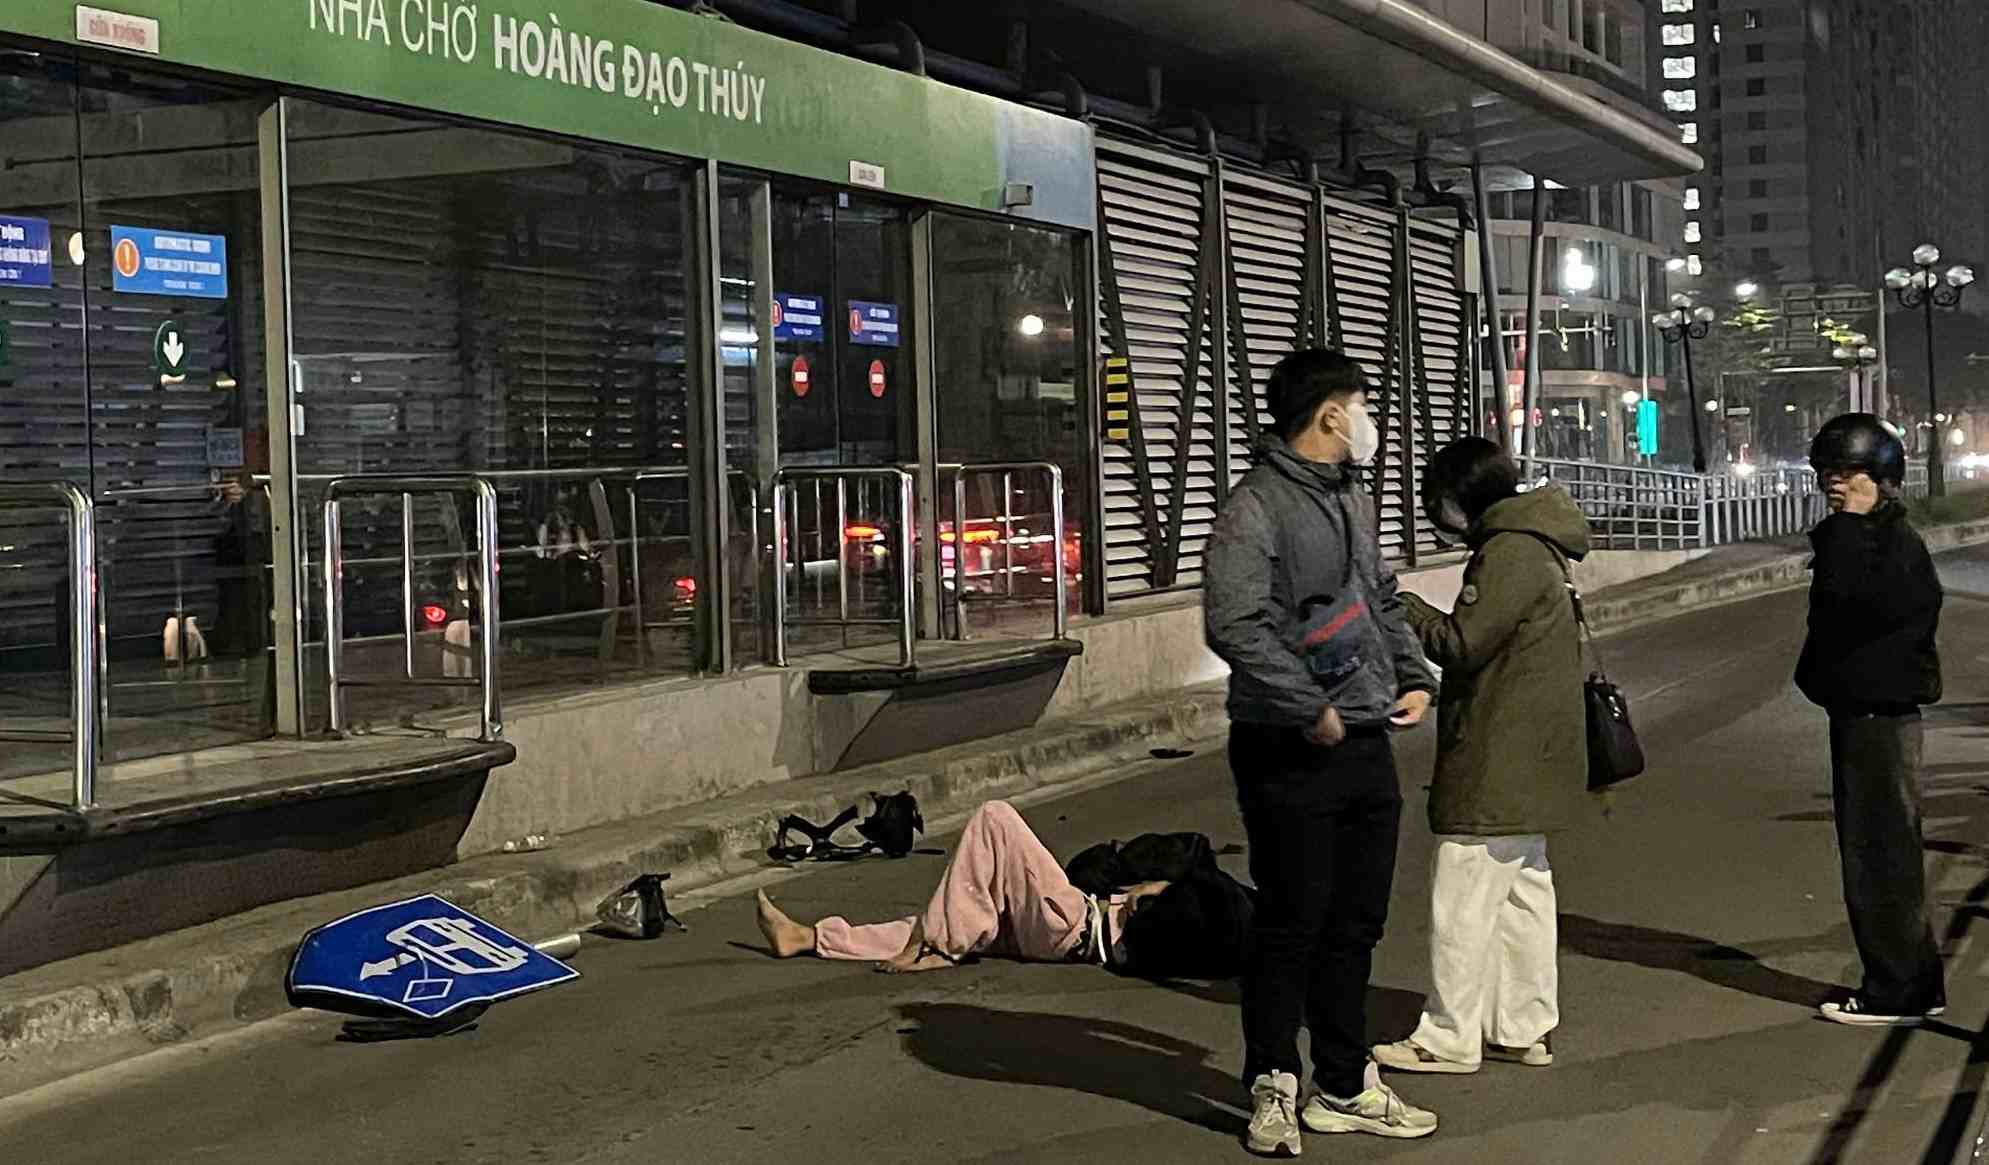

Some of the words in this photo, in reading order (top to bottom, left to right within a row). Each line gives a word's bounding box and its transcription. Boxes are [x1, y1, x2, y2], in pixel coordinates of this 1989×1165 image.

[493, 12, 616, 93] HOÀNG
[622, 44, 689, 116] ĐẠO
[692, 60, 766, 124] THÚY
